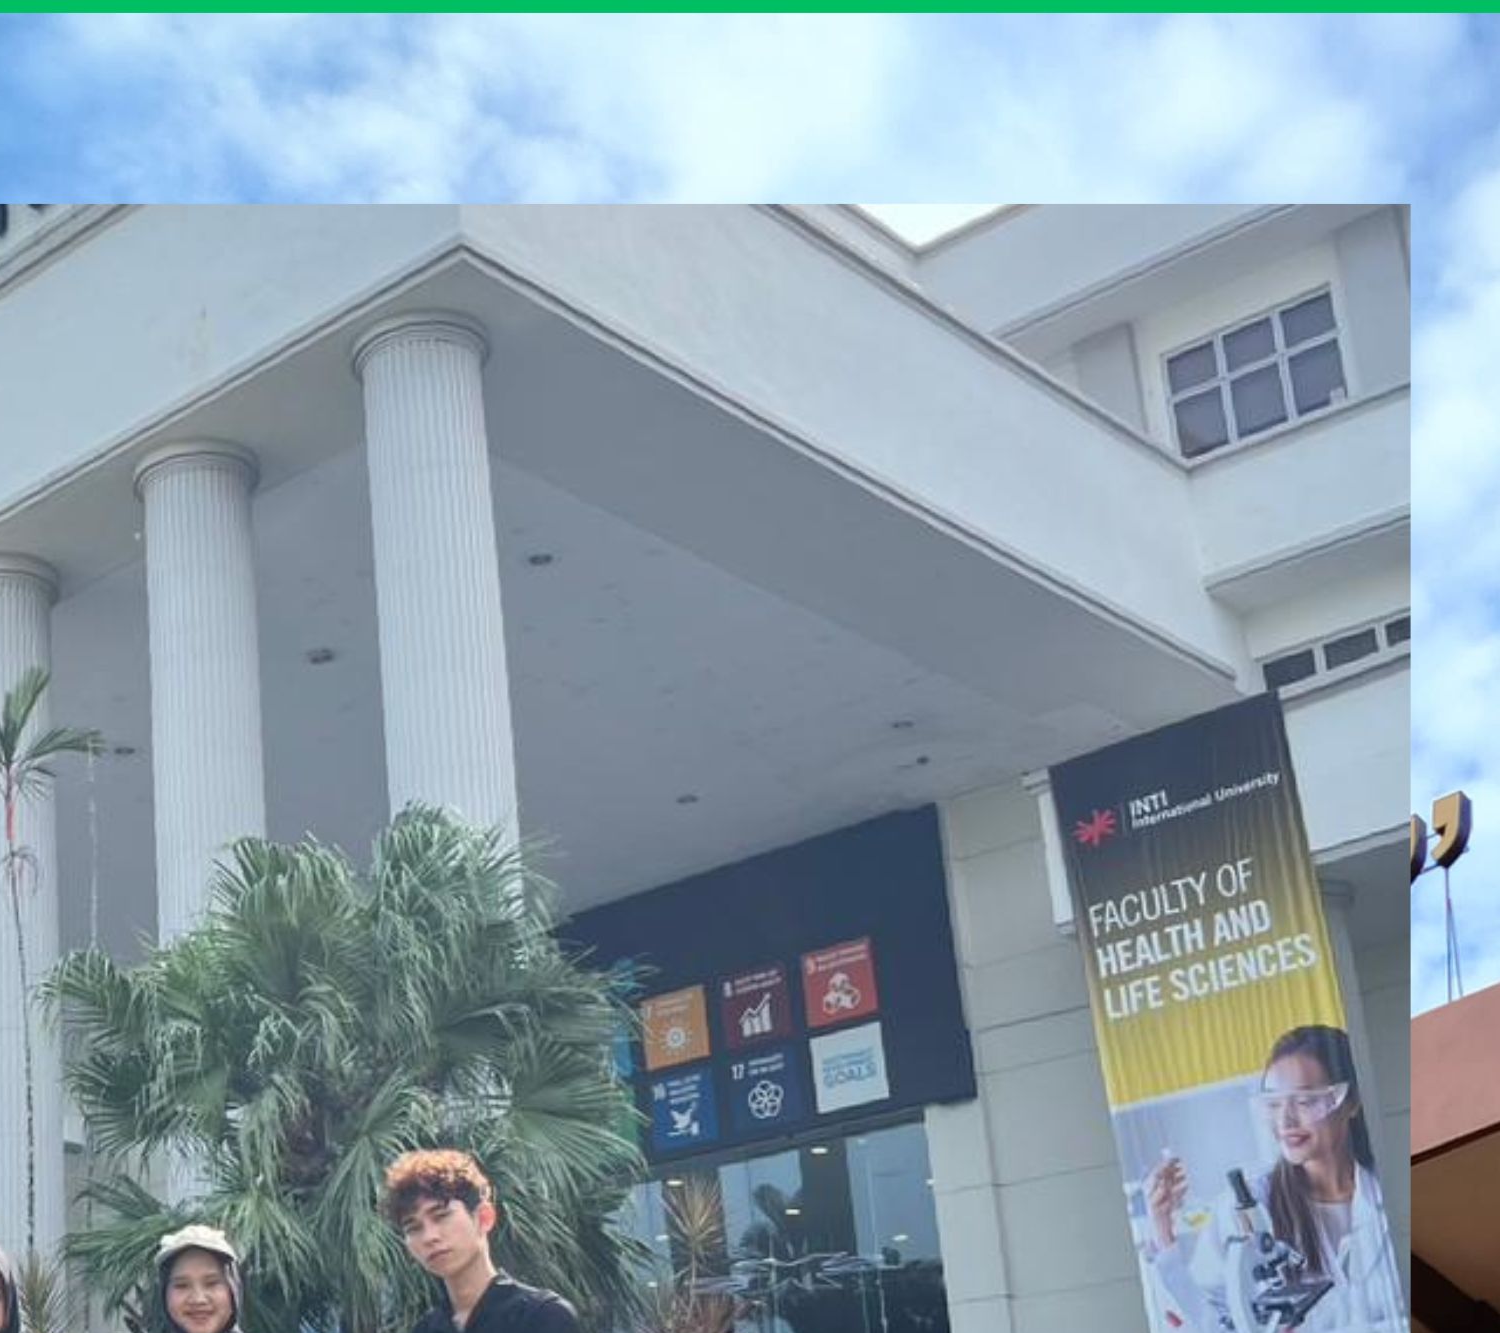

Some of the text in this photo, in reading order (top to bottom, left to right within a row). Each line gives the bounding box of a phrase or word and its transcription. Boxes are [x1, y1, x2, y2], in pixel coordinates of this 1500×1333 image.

[1129, 790, 1168, 817] INTI
[1131, 771, 1280, 829] International University
[1088, 858, 1254, 937] FACULTY OF
[1097, 900, 1271, 979] HEALTH AND
[1104, 933, 1317, 1019] LIFE SCIENCES
